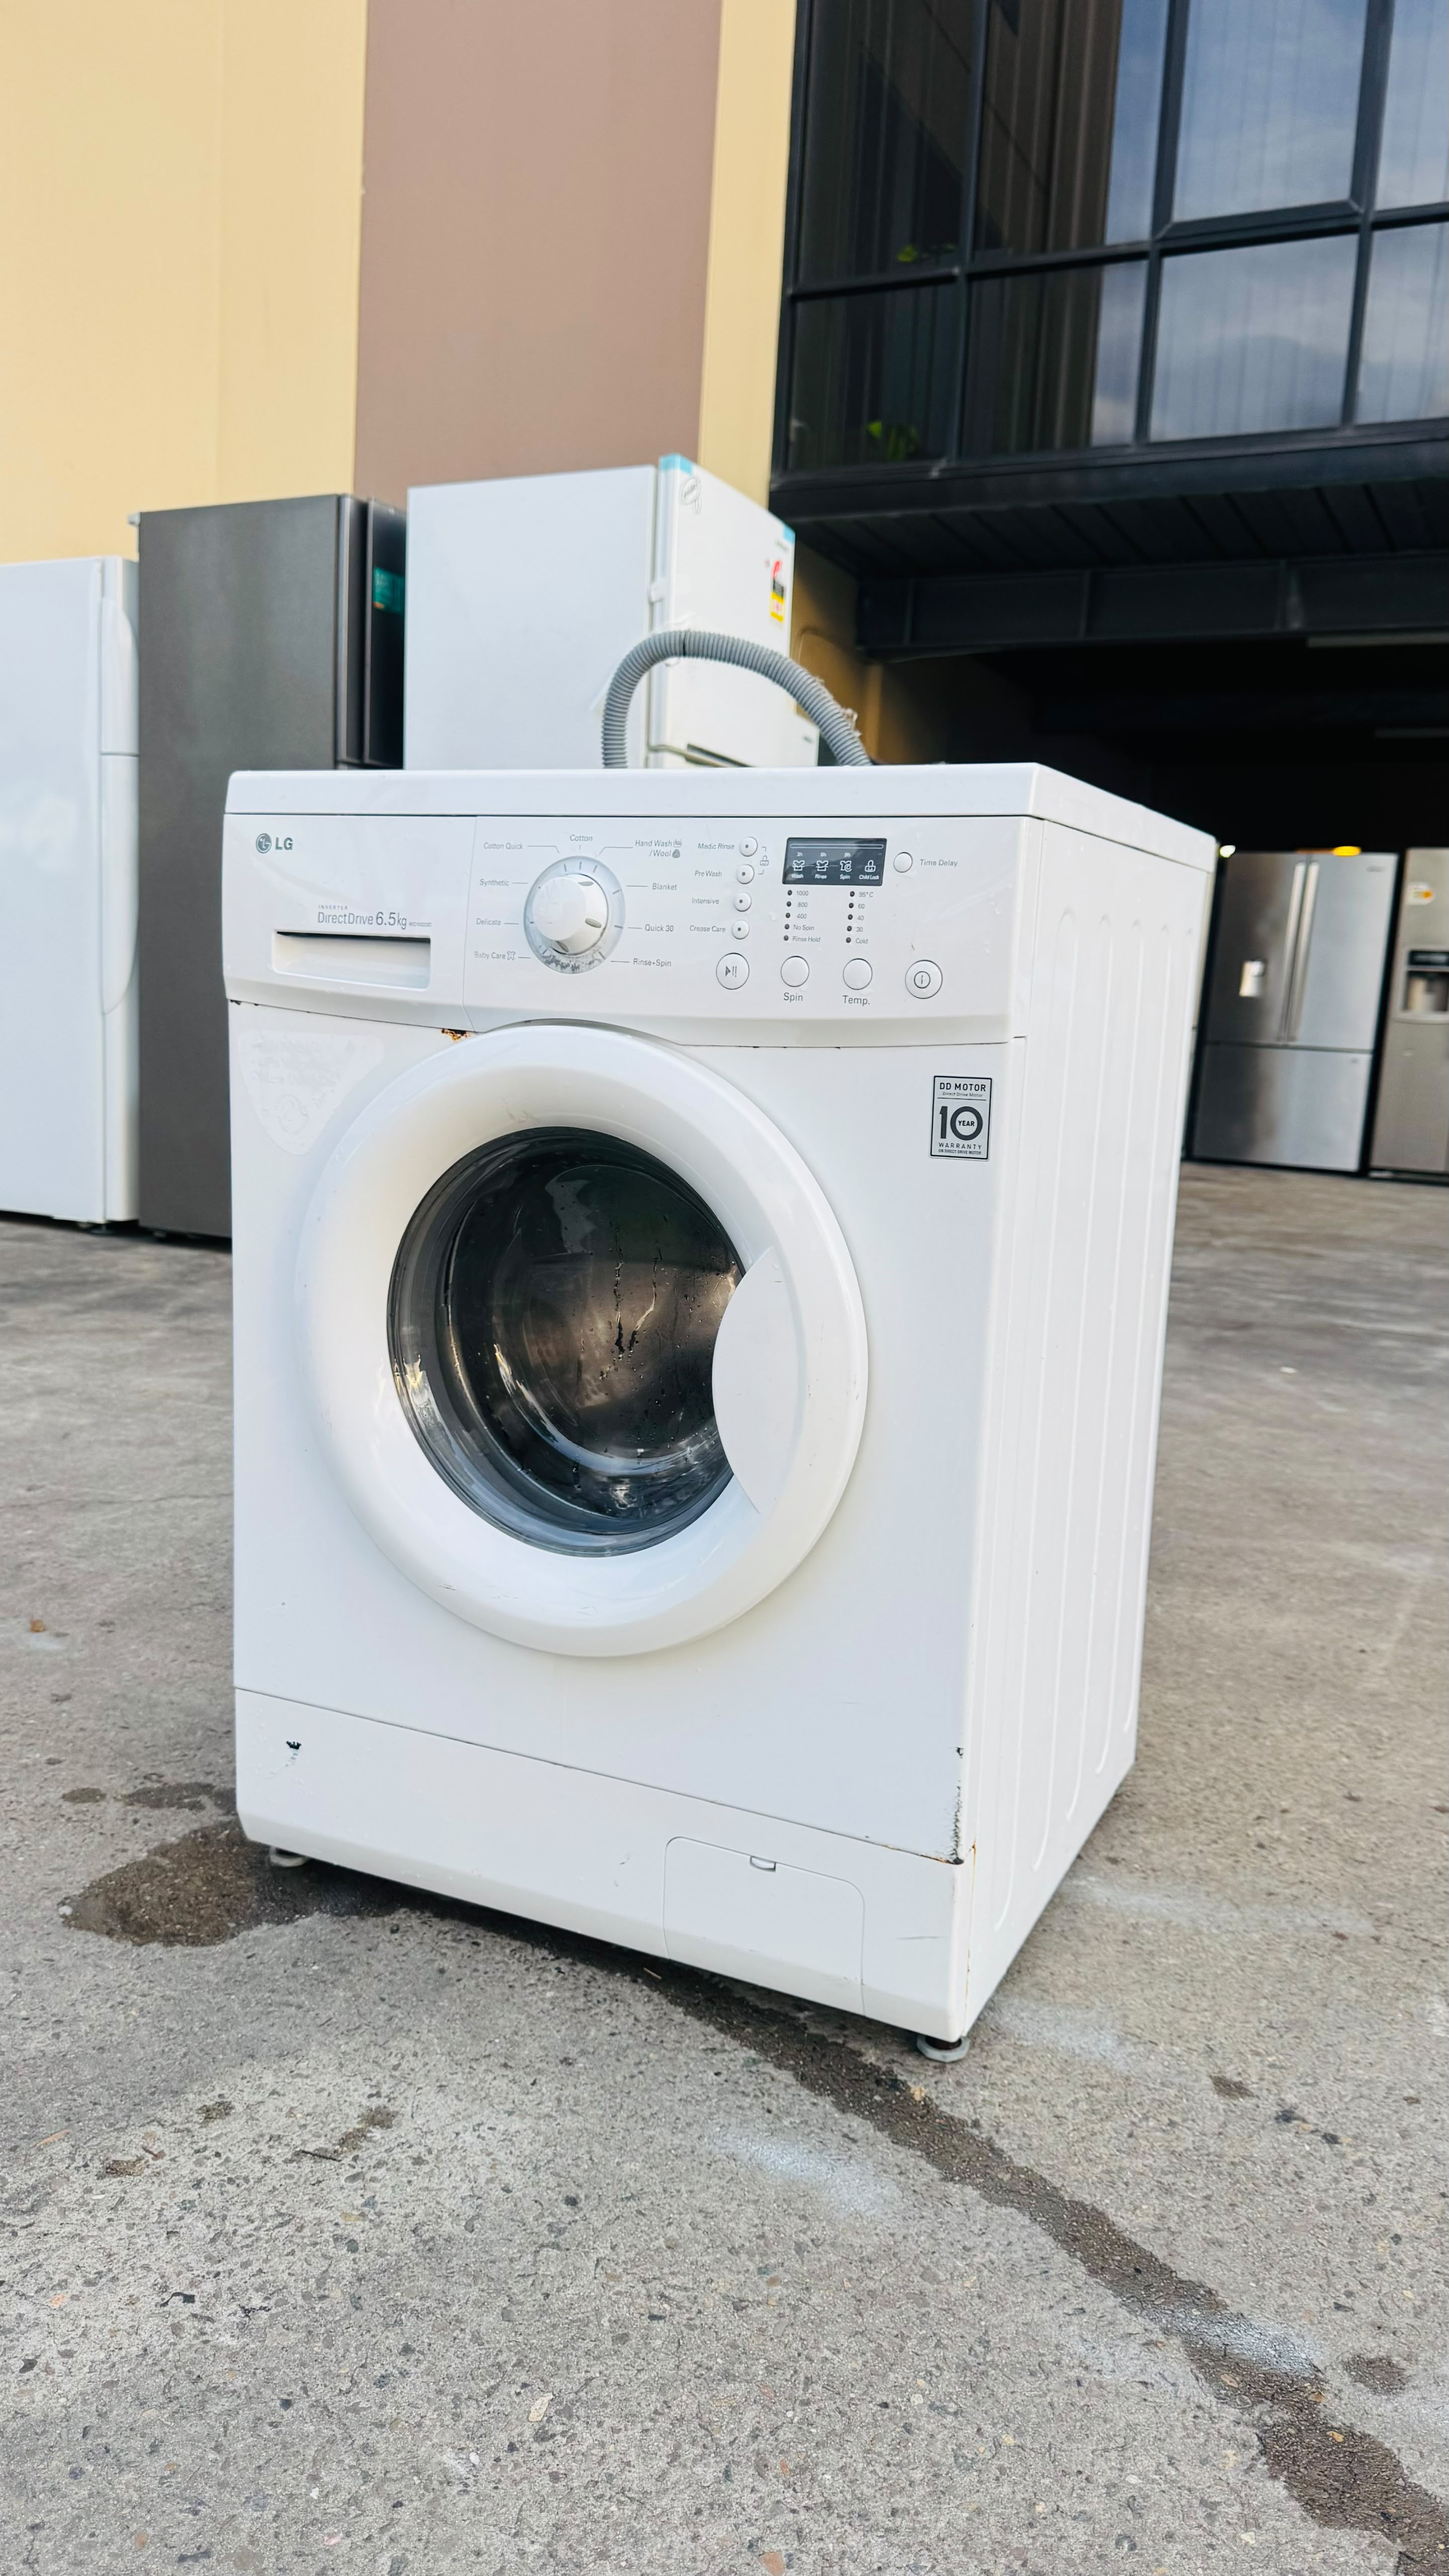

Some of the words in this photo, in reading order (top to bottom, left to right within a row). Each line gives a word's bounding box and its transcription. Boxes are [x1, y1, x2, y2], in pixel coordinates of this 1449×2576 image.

[276, 837, 293, 850] LG
[938, 859, 958, 867] Delay
[479, 878, 510, 887] Synthetic
[375, 911, 407, 930] 6.5kg
[645, 924, 664, 932] Quick
[474, 951, 490, 960] Baby
[491, 951, 506, 959] Care
[783, 992, 803, 1002] Spin
[842, 995, 870, 1006] Temp.
[955, 1083, 986, 1092] MOTOR
[939, 1106, 983, 1141] 10
[938, 1142, 982, 1150] WARRANTY
